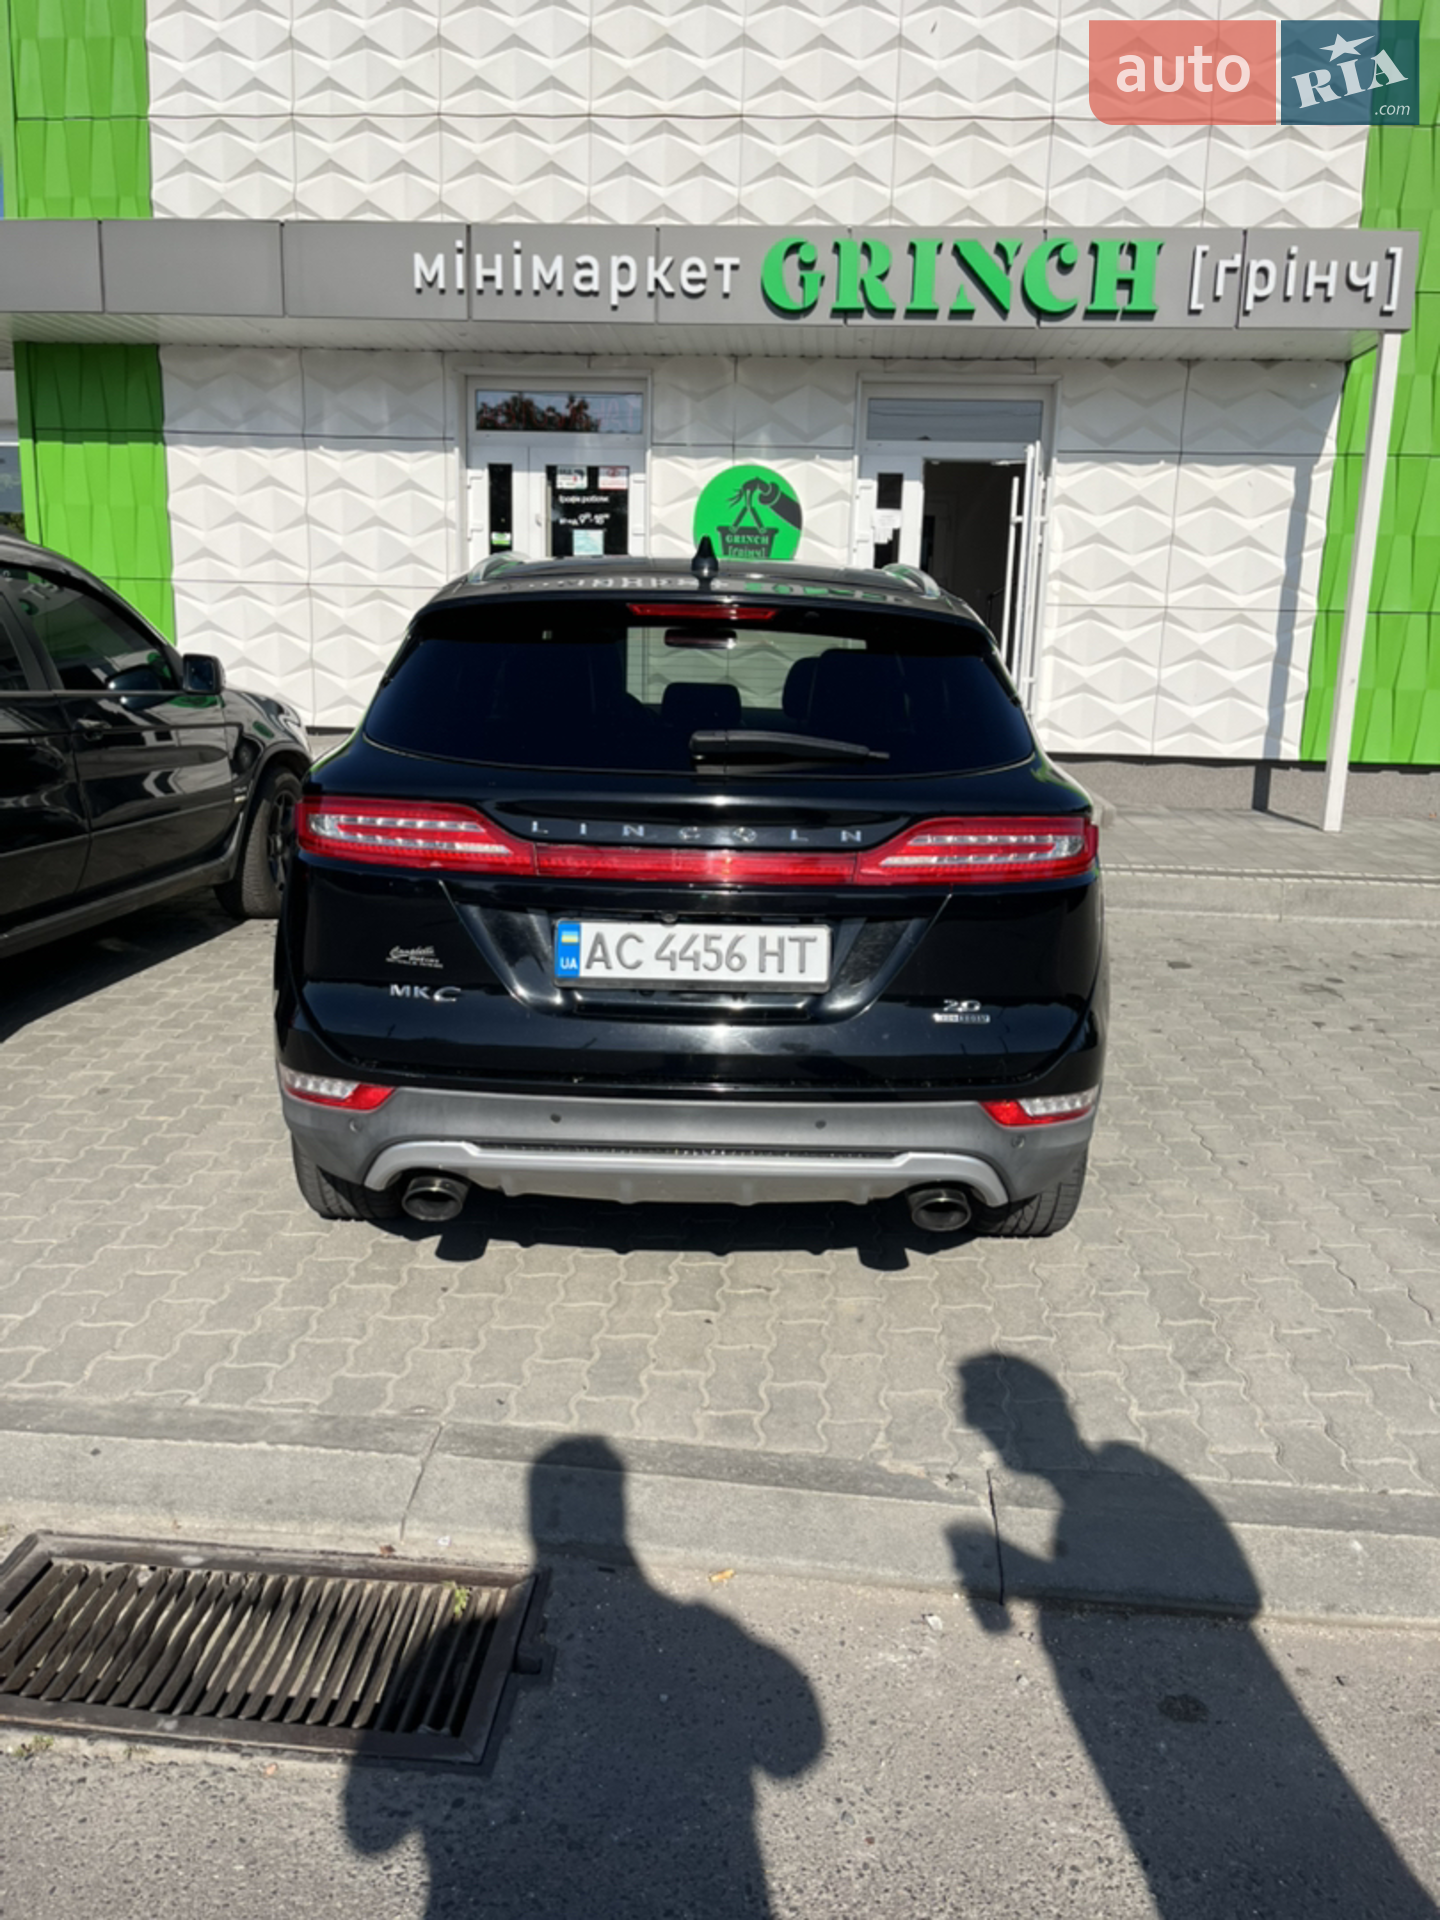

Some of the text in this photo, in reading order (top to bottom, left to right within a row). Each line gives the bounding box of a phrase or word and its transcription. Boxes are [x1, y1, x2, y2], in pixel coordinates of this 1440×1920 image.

[413, 240, 741, 308] мінімаркет
[761, 236, 1165, 317] GRINCH
[724, 533, 769, 545] GRINCH
[532, 820, 862, 843] LINCOLN
[560, 957, 578, 970] UA
[585, 932, 817, 974] AC 4456 HT
[390, 983, 461, 1002] MKC
